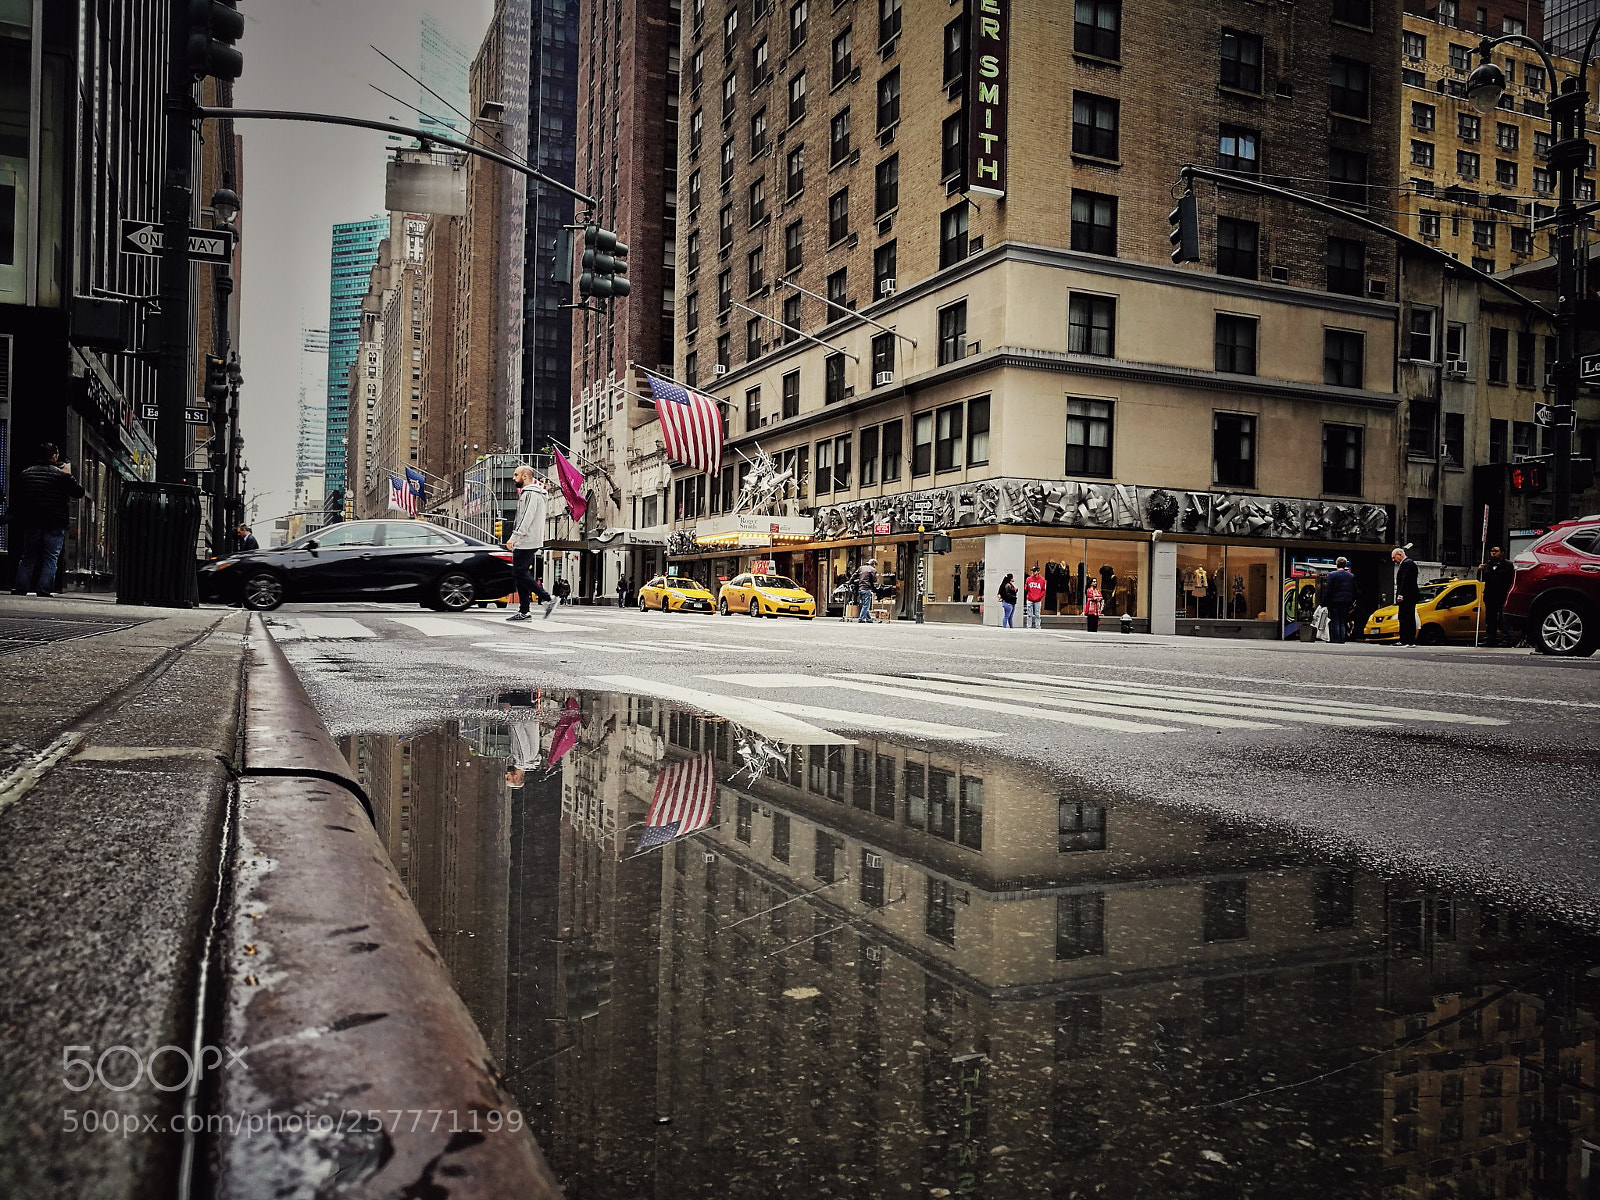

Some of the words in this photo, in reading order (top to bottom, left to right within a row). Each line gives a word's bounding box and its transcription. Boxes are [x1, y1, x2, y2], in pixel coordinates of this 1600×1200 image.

[979, 0, 1001, 41] ER
[978, 55, 1000, 181] SMITH
[138, 232, 164, 250] ON
[193, 412, 204, 422] St
